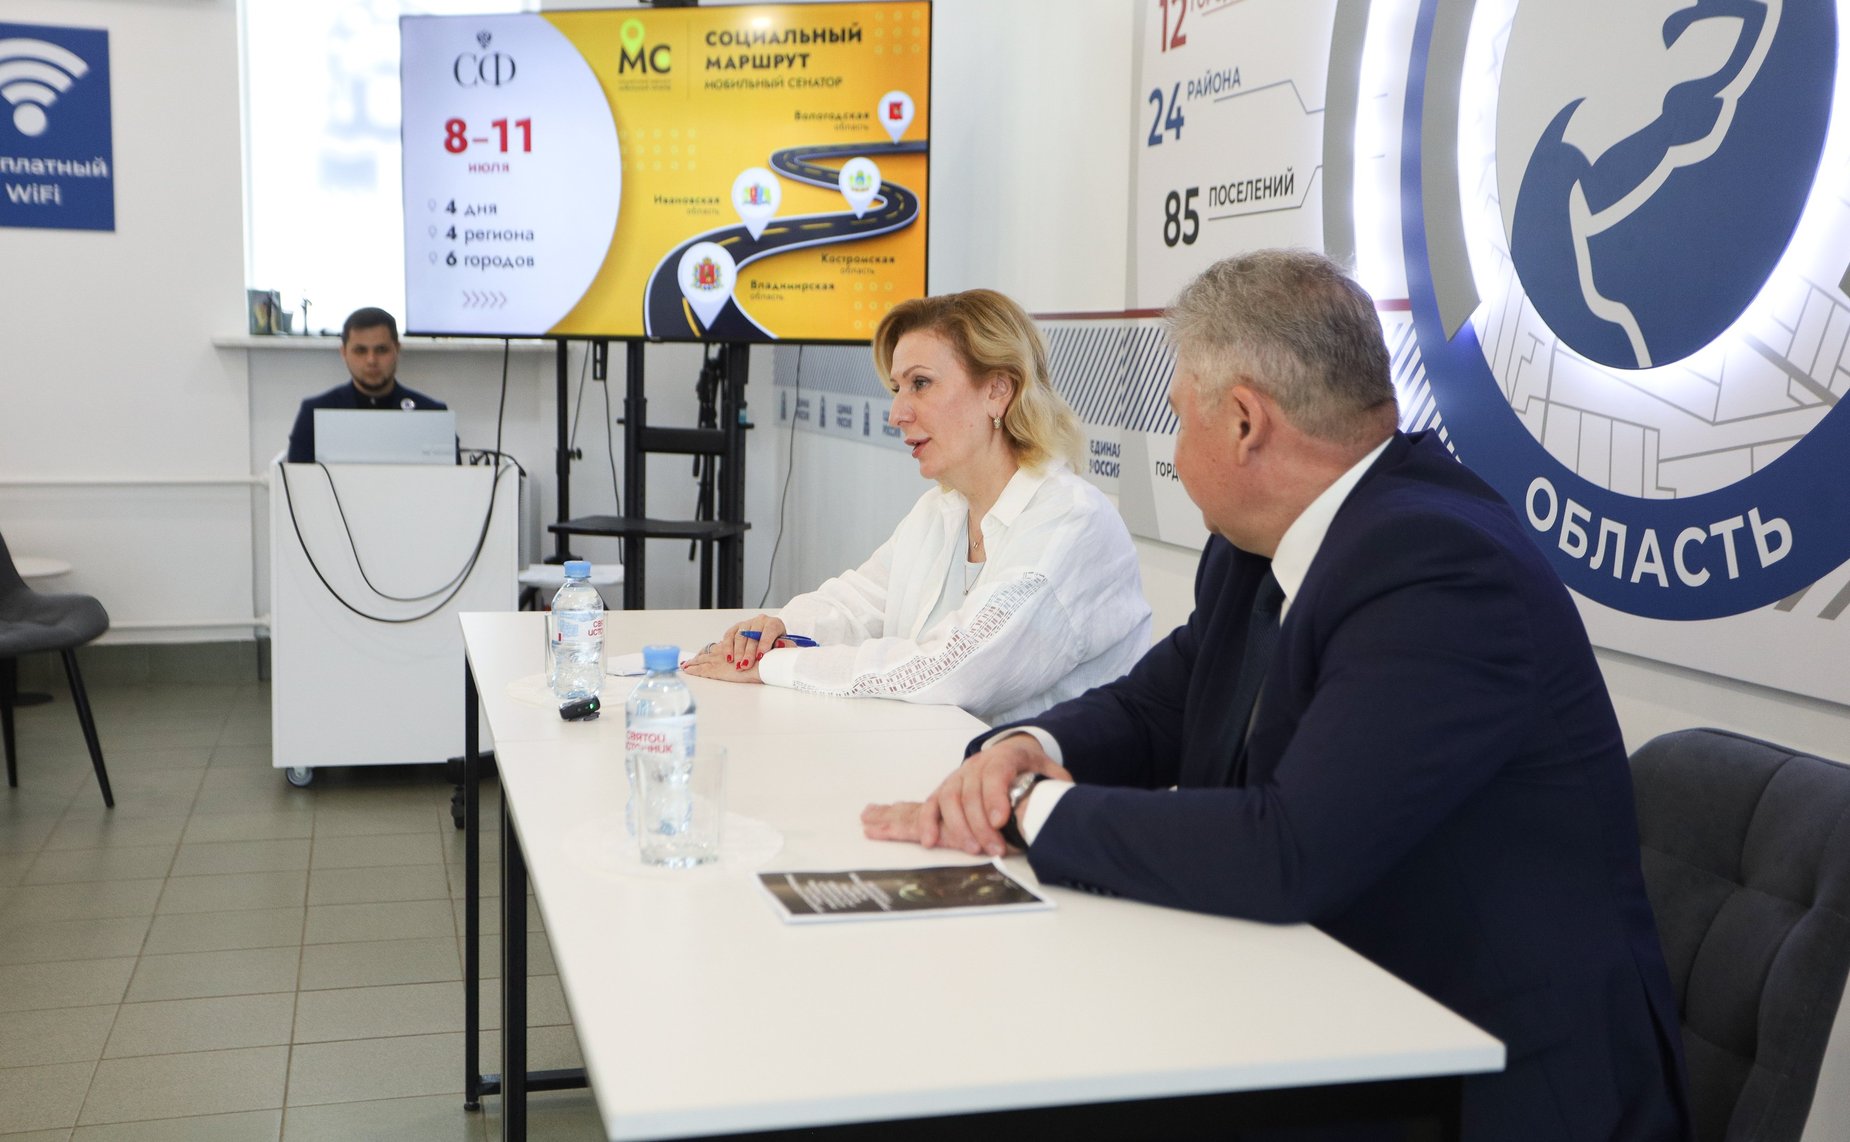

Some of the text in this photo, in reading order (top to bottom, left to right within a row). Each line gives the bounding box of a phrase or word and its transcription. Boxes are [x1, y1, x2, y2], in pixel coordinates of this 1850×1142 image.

[705, 22, 862, 47] СОЦИАЛЬНЫЙ
[1159, 0, 1187, 53] 12
[453, 50, 516, 87] СФ
[618, 44, 671, 74] МС
[705, 53, 809, 70] МАРШРУТ
[704, 75, 842, 90] МОБИЛЬНЫЙ СЕНАТОР
[1147, 66, 1241, 147] 24 РАЙОНА
[468, 162, 510, 174] июля
[5, 182, 61, 205] WiFi
[445, 199, 498, 216] 4 дня
[1163, 166, 1295, 248] 85 ПОСЕЛЕНИЙ
[446, 225, 535, 244] 4 региона
[446, 250, 535, 270] 6 городов
[821, 253, 895, 266] Костромская
[750, 280, 835, 292] Владимирская
[1525, 476, 1793, 588] ОБЛАСТЬ
